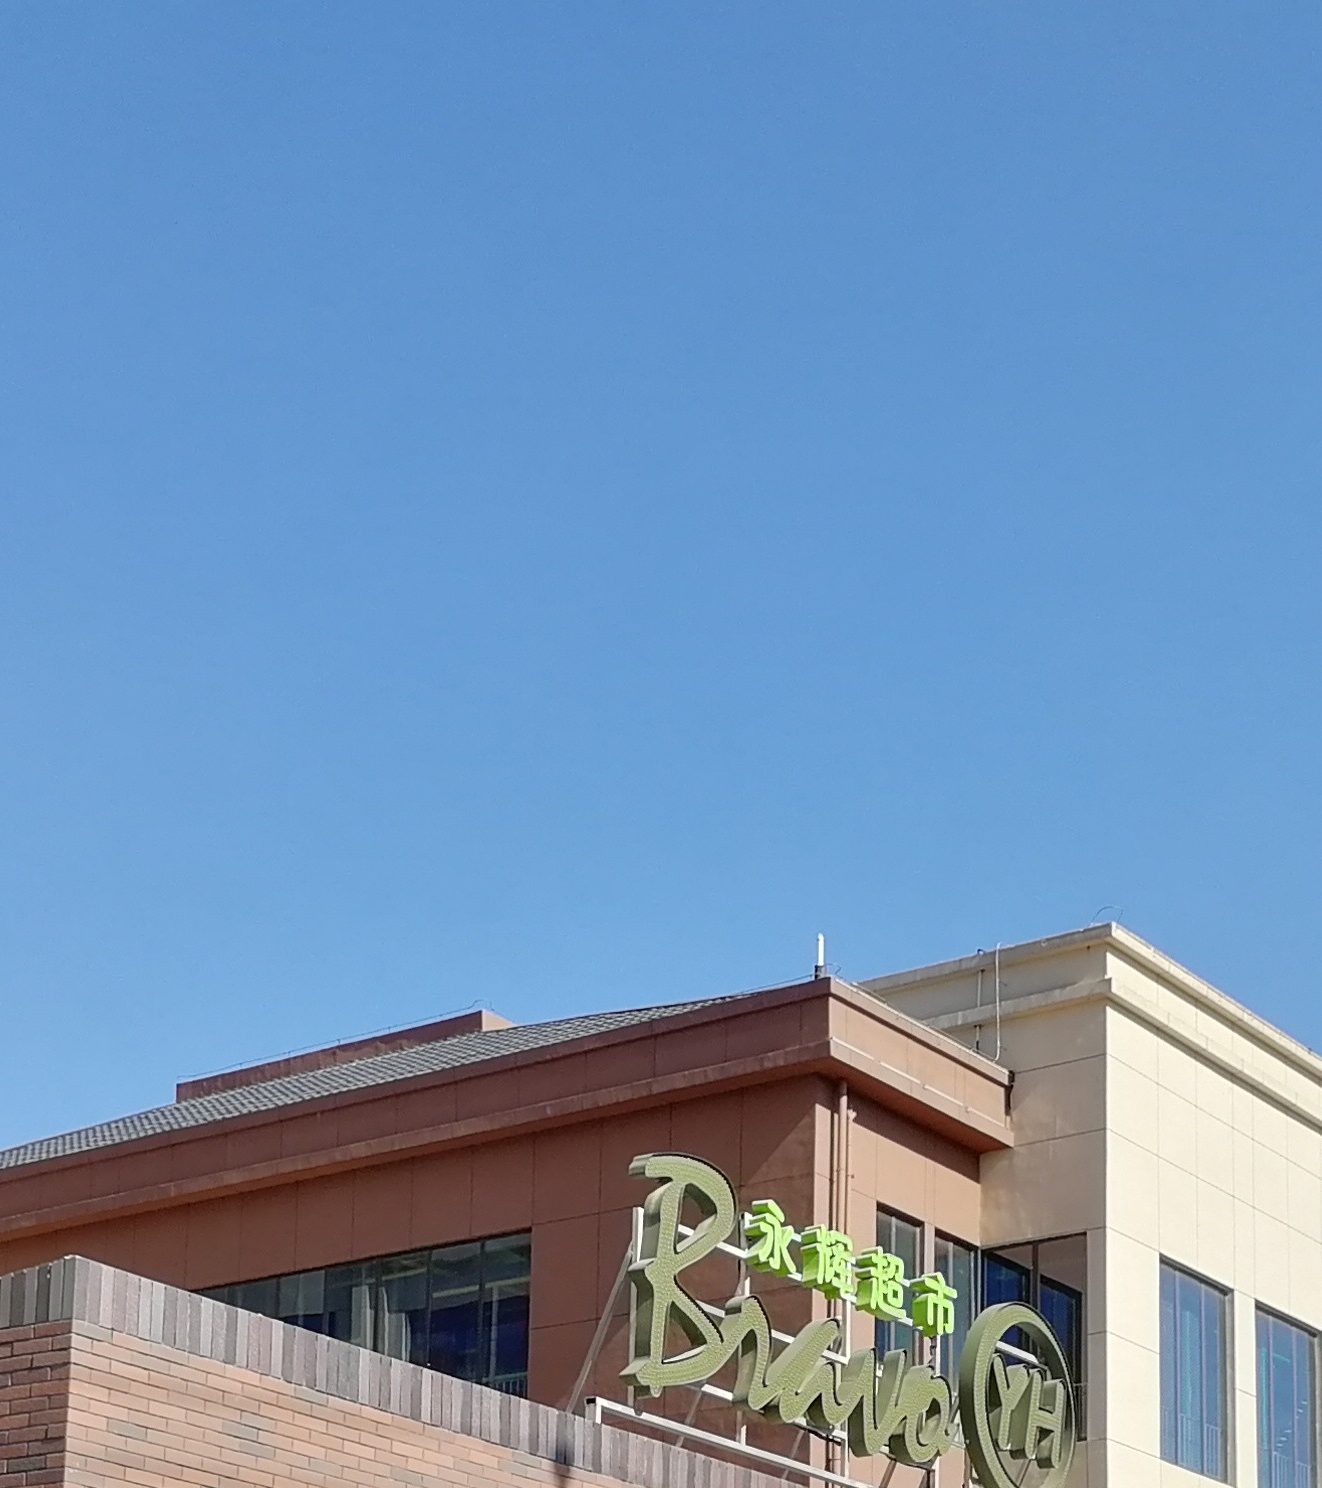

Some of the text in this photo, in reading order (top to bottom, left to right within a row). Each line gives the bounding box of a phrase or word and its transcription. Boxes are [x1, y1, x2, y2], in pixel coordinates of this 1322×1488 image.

[620, 1152, 964, 1468] Bravo
[743, 1198, 958, 1338] 永辉超市
